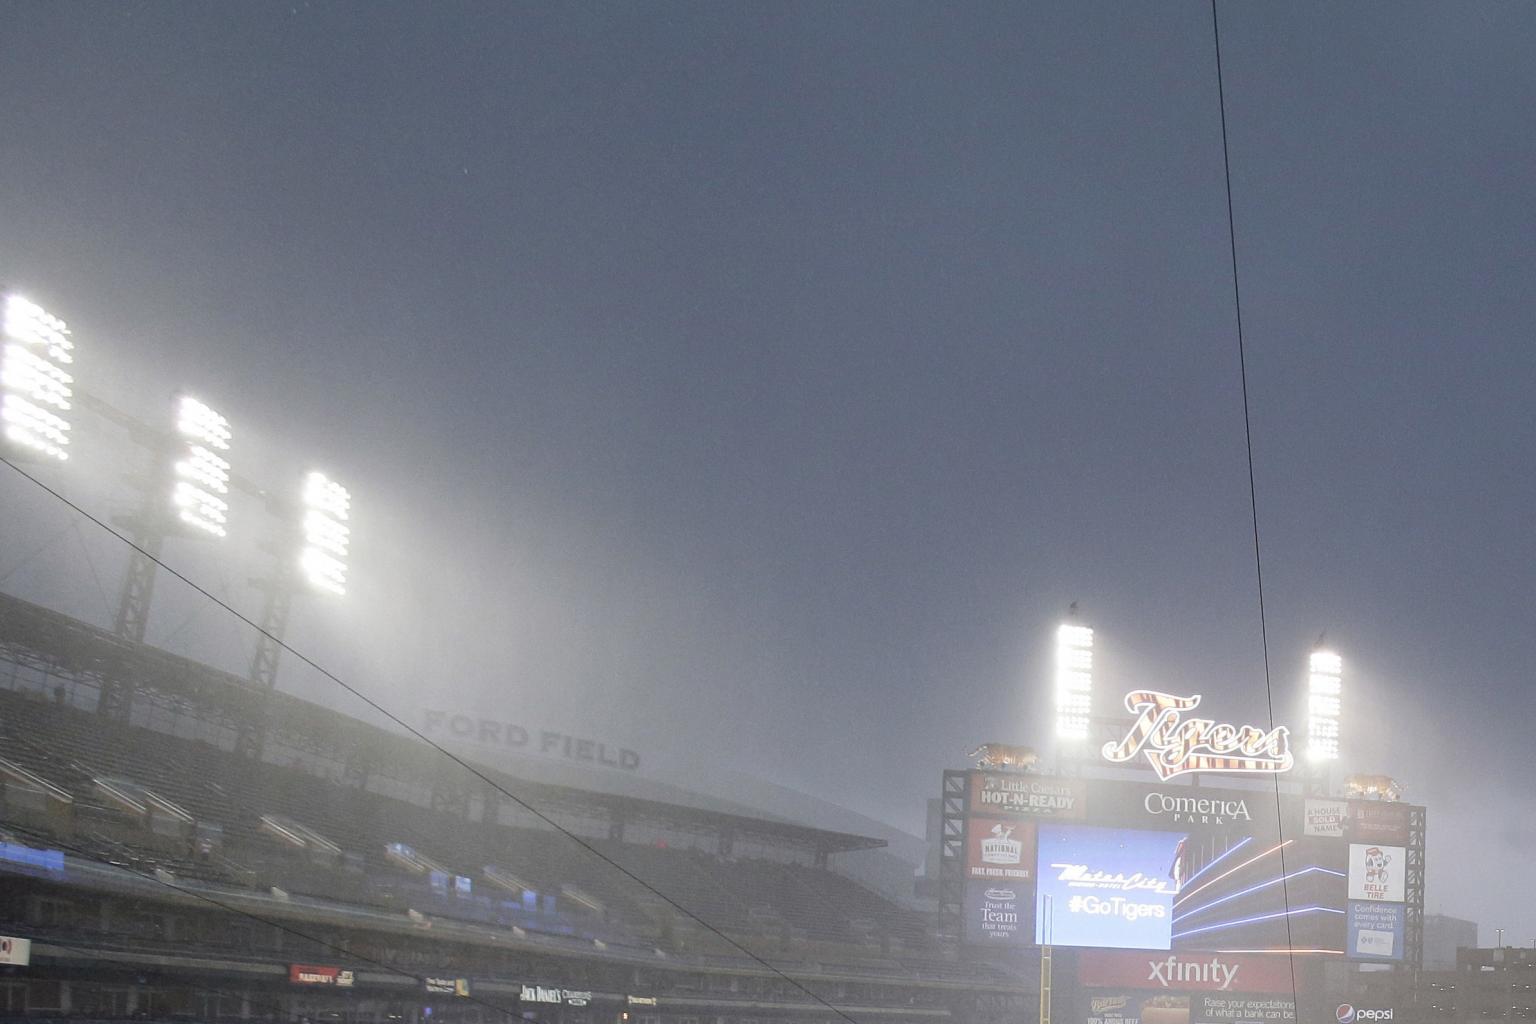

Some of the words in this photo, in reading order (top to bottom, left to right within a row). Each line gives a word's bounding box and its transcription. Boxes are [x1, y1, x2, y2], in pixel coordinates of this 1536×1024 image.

[424, 710, 528, 747] FORD
[540, 730, 641, 770] FIELD
[1102, 690, 1294, 781] Tigers
[1001, 780, 1028, 791] Little
[980, 791, 1075, 809] HOT-N-READY
[1174, 814, 1223, 824] PARK
[1364, 883, 1389, 892] BELLE
[1367, 891, 1385, 899] TIRE
[981, 907, 1017, 922] Team
[1068, 895, 1166, 921] #GoTigers
[1147, 956, 1240, 990] xfinity
[1204, 998, 1226, 1008] Raise
[1227, 1001, 1246, 1010] your
[1247, 1000, 1295, 1010] expectations
[1215, 1009, 1235, 1017] what
[1244, 1009, 1264, 1017] bank
[1357, 1007, 1393, 1022] pepsi
